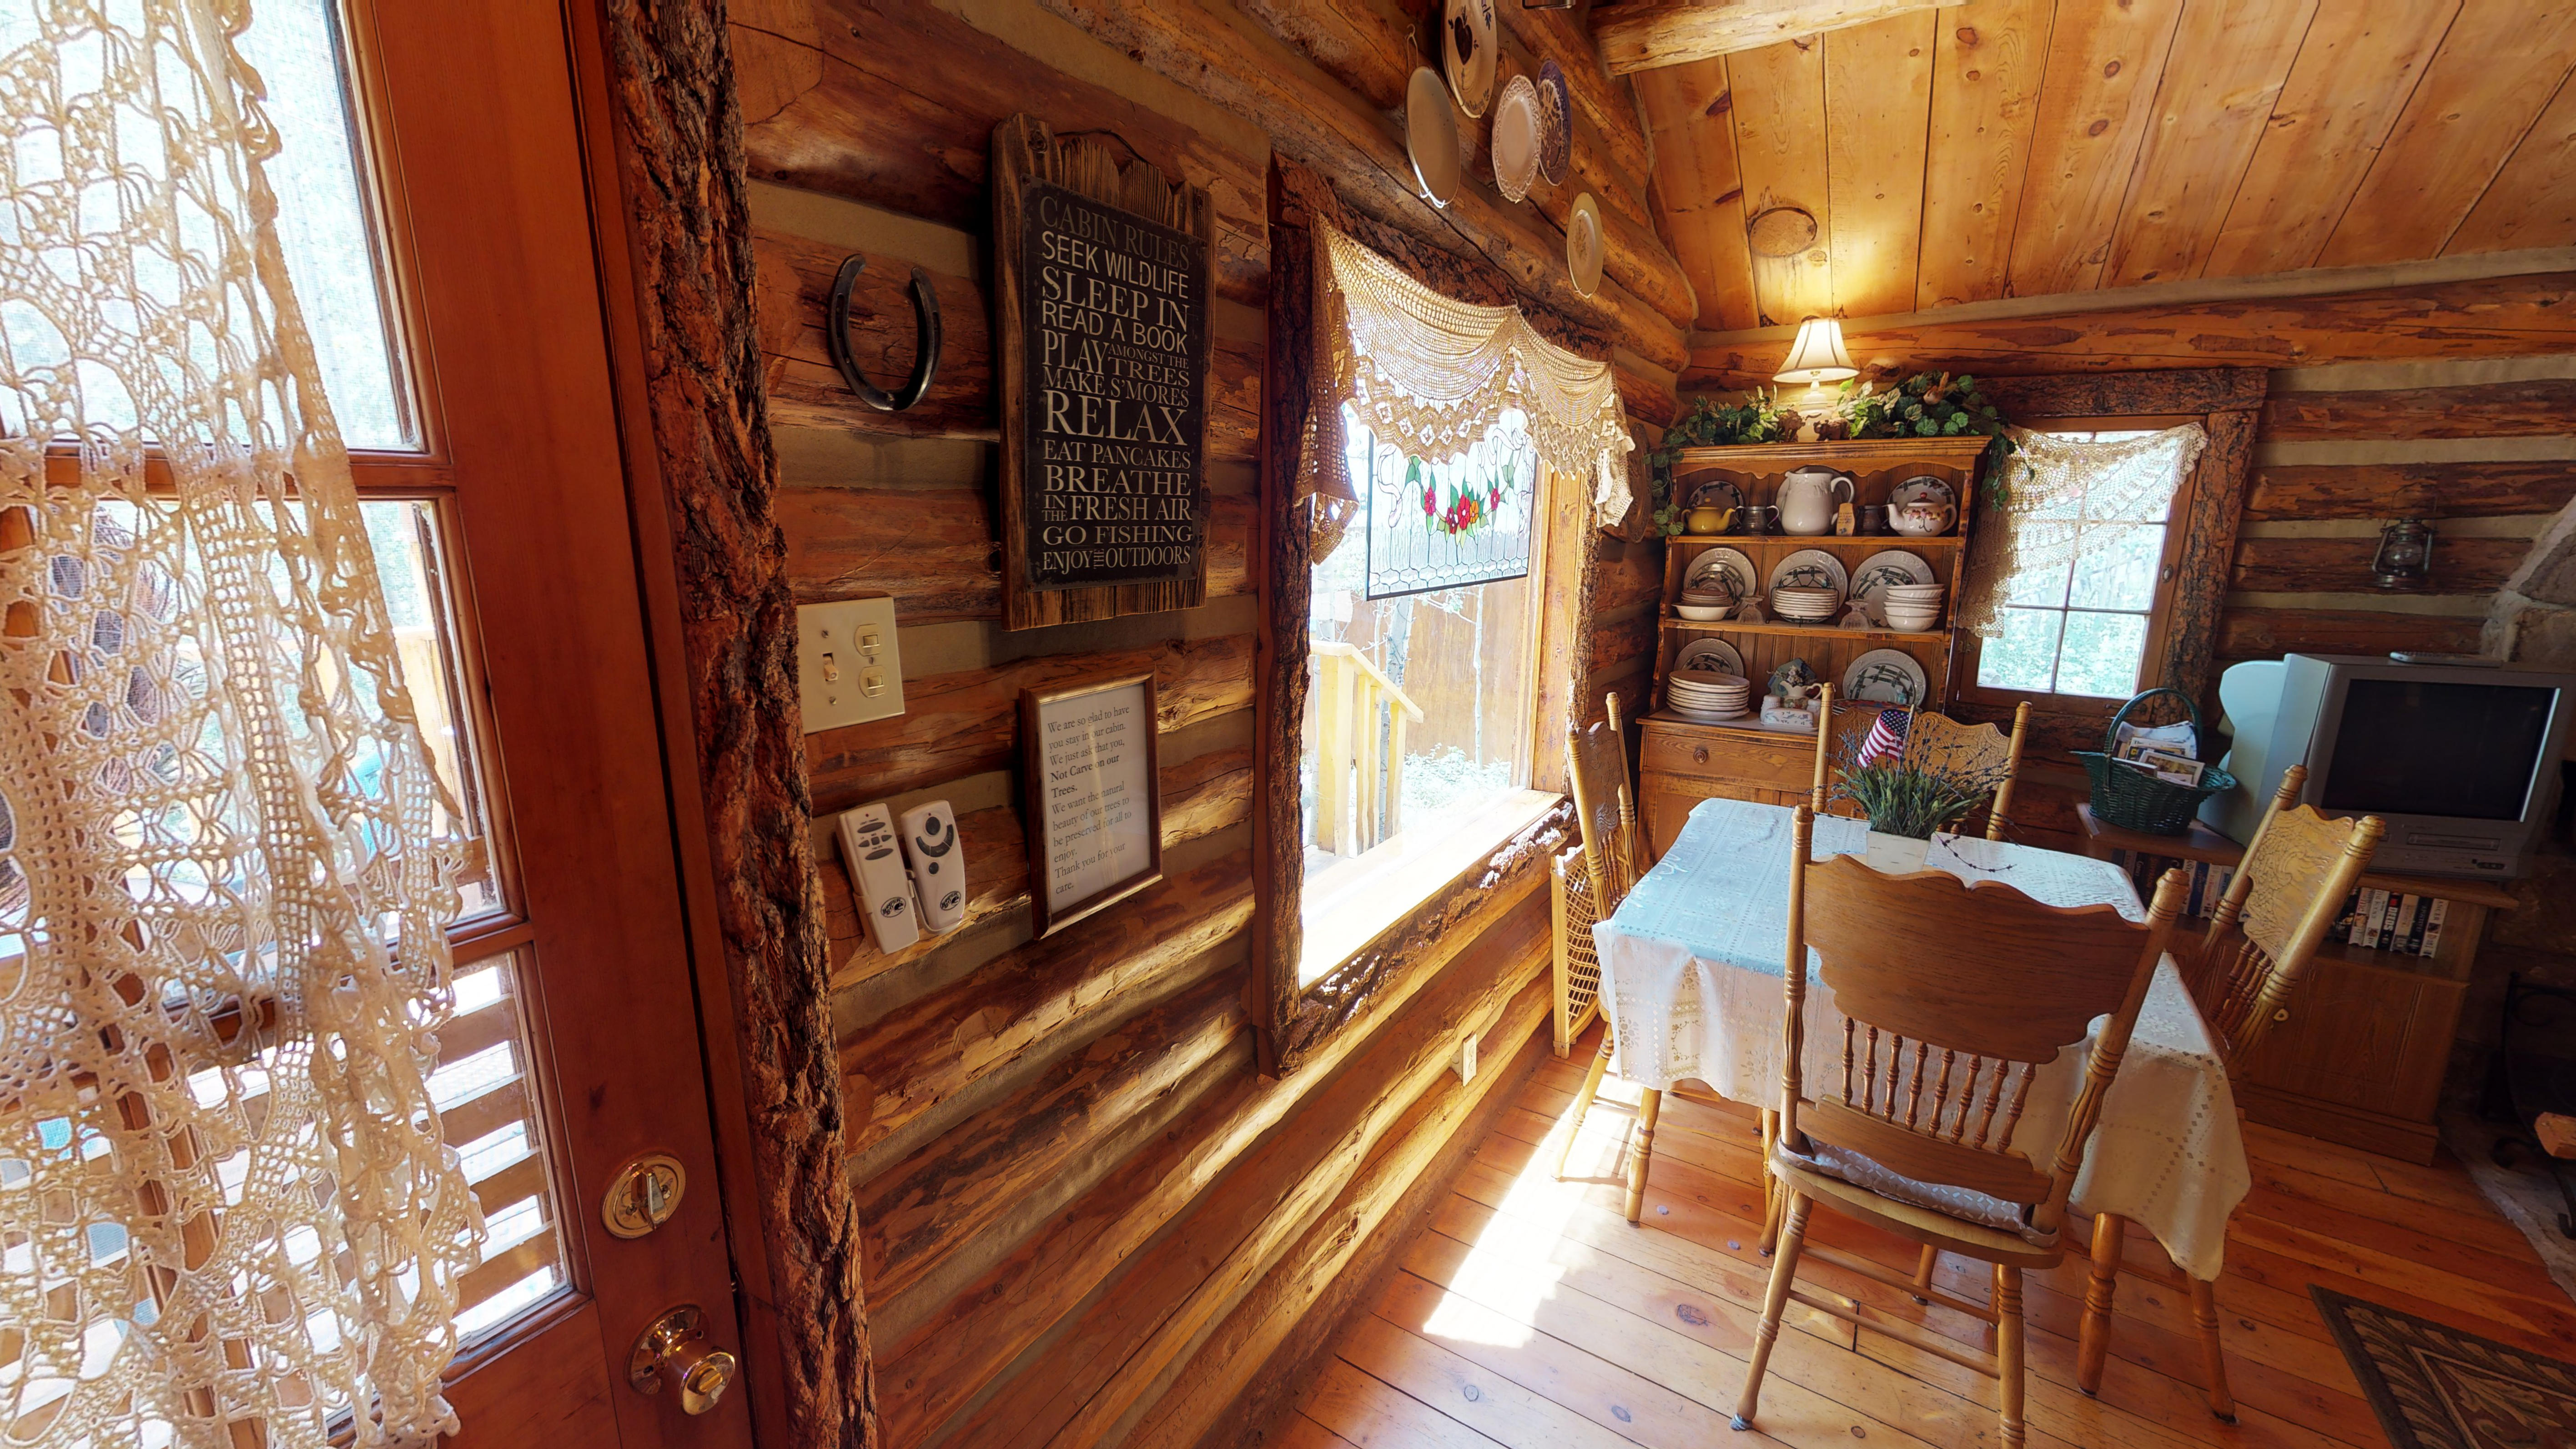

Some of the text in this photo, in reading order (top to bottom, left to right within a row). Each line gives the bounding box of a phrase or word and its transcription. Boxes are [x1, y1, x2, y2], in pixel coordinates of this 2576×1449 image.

[1040, 196, 1189, 271] CABIN RULES
[1042, 231, 1188, 299] SEEK WILDLIFE
[1042, 266, 1190, 332] SLEEP IN
[1042, 300, 1188, 355] READ A BOOK
[1041, 329, 1189, 375] PLAY AMONGST THE
[1042, 366, 1189, 407] MAKE S'MORES
[1107, 357, 1190, 387] TREES
[1042, 389, 1187, 446] RELAX
[1043, 439, 1191, 469] EAT PANCAKES
[1043, 464, 1191, 496] BREATHE
[1041, 510, 1068, 521] THE
[1043, 495, 1192, 520] IN FRESH AIR
[1043, 525, 1193, 545] GO FISHING
[1042, 546, 1191, 575] ENJOY THE OUTDOORS
[1048, 706, 1130, 733] We are so glad to have
[1048, 739, 1063, 753] you
[1066, 735, 1080, 746] stay
[1082, 731, 1090, 741] in
[1091, 728, 1104, 738] our
[1050, 754, 1063, 766] We
[1066, 751, 1079, 765] just
[1081, 745, 1093, 757] ask
[1095, 742, 1108, 753] that
[1050, 755, 1120, 782] Not Carve on our
[1051, 785, 1077, 798] Trees.
[1052, 781, 1125, 815] We want the natural
[1052, 797, 1130, 831] beauty of our trees to
[1053, 810, 1132, 847] be preserved for all to
[1054, 848, 1077, 862] enjoy.
[1055, 843, 1126, 878] Thank you for your
[1056, 881, 1074, 895] care.
